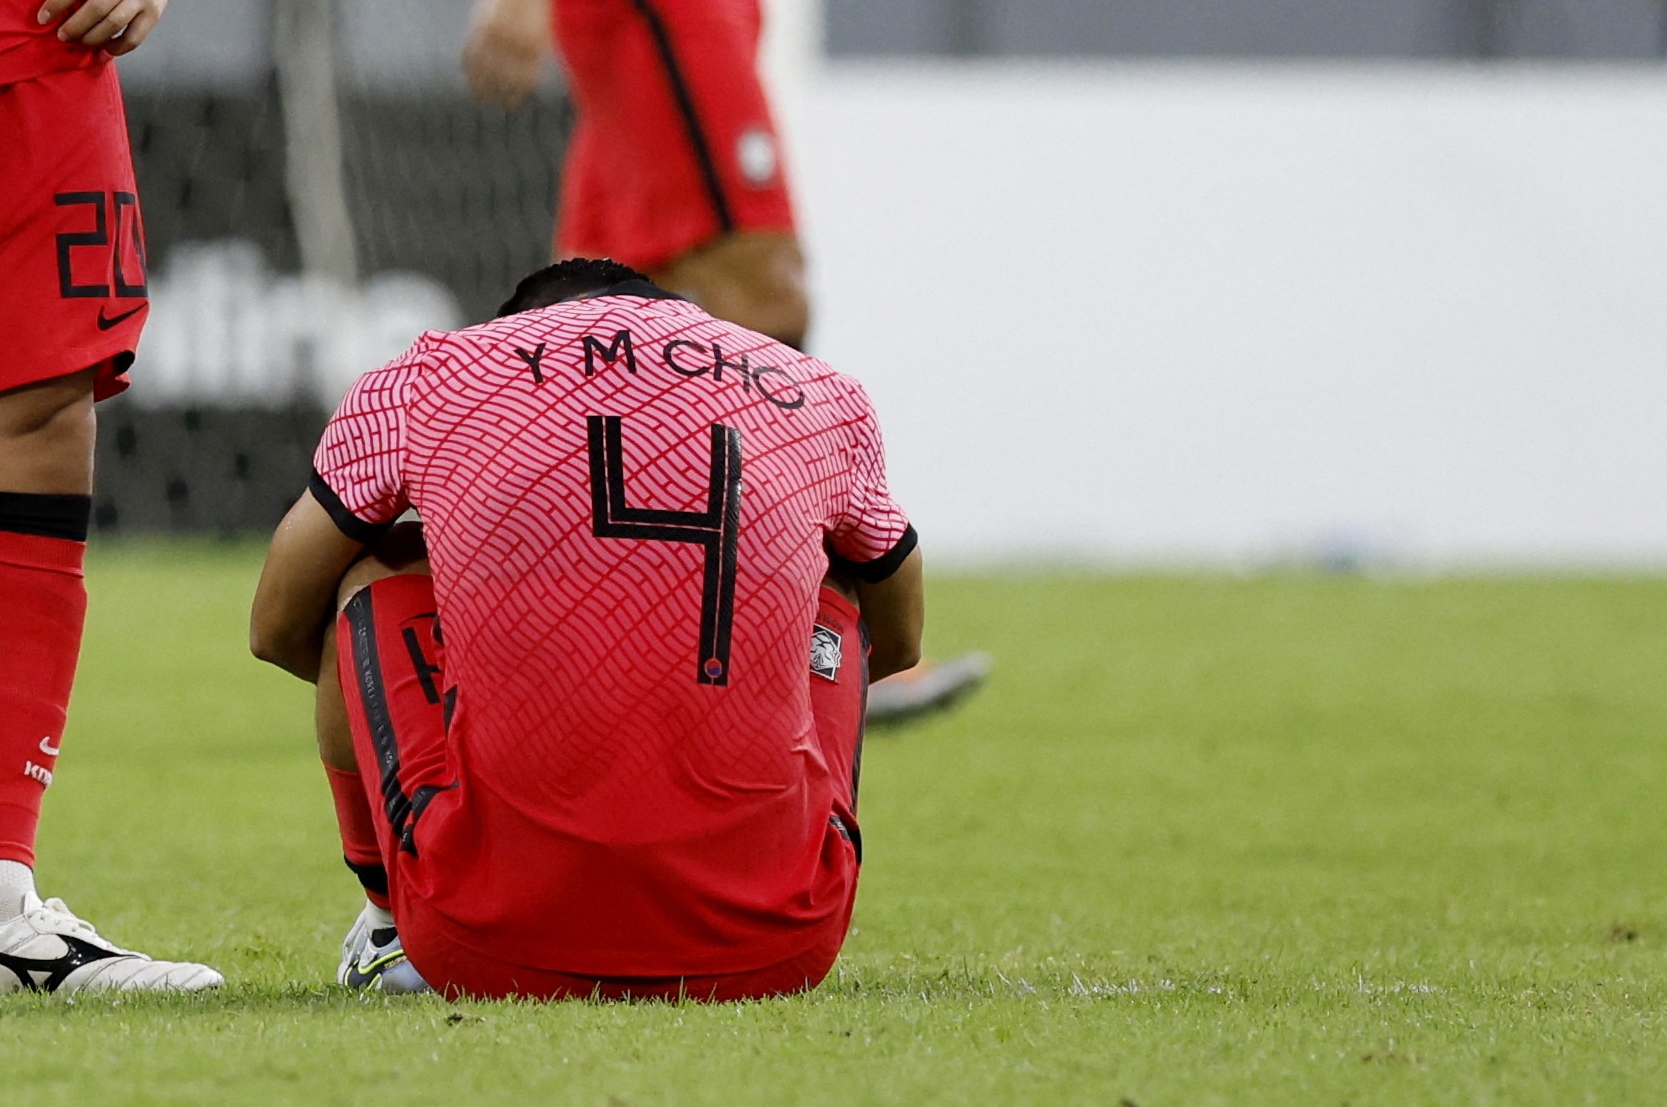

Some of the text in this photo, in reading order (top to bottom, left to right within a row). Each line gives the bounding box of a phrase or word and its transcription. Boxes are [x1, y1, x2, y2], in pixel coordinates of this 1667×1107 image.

[54, 191, 149, 298] 20
[514, 329, 805, 410] Y M CHO
[586, 415, 743, 686] 4
